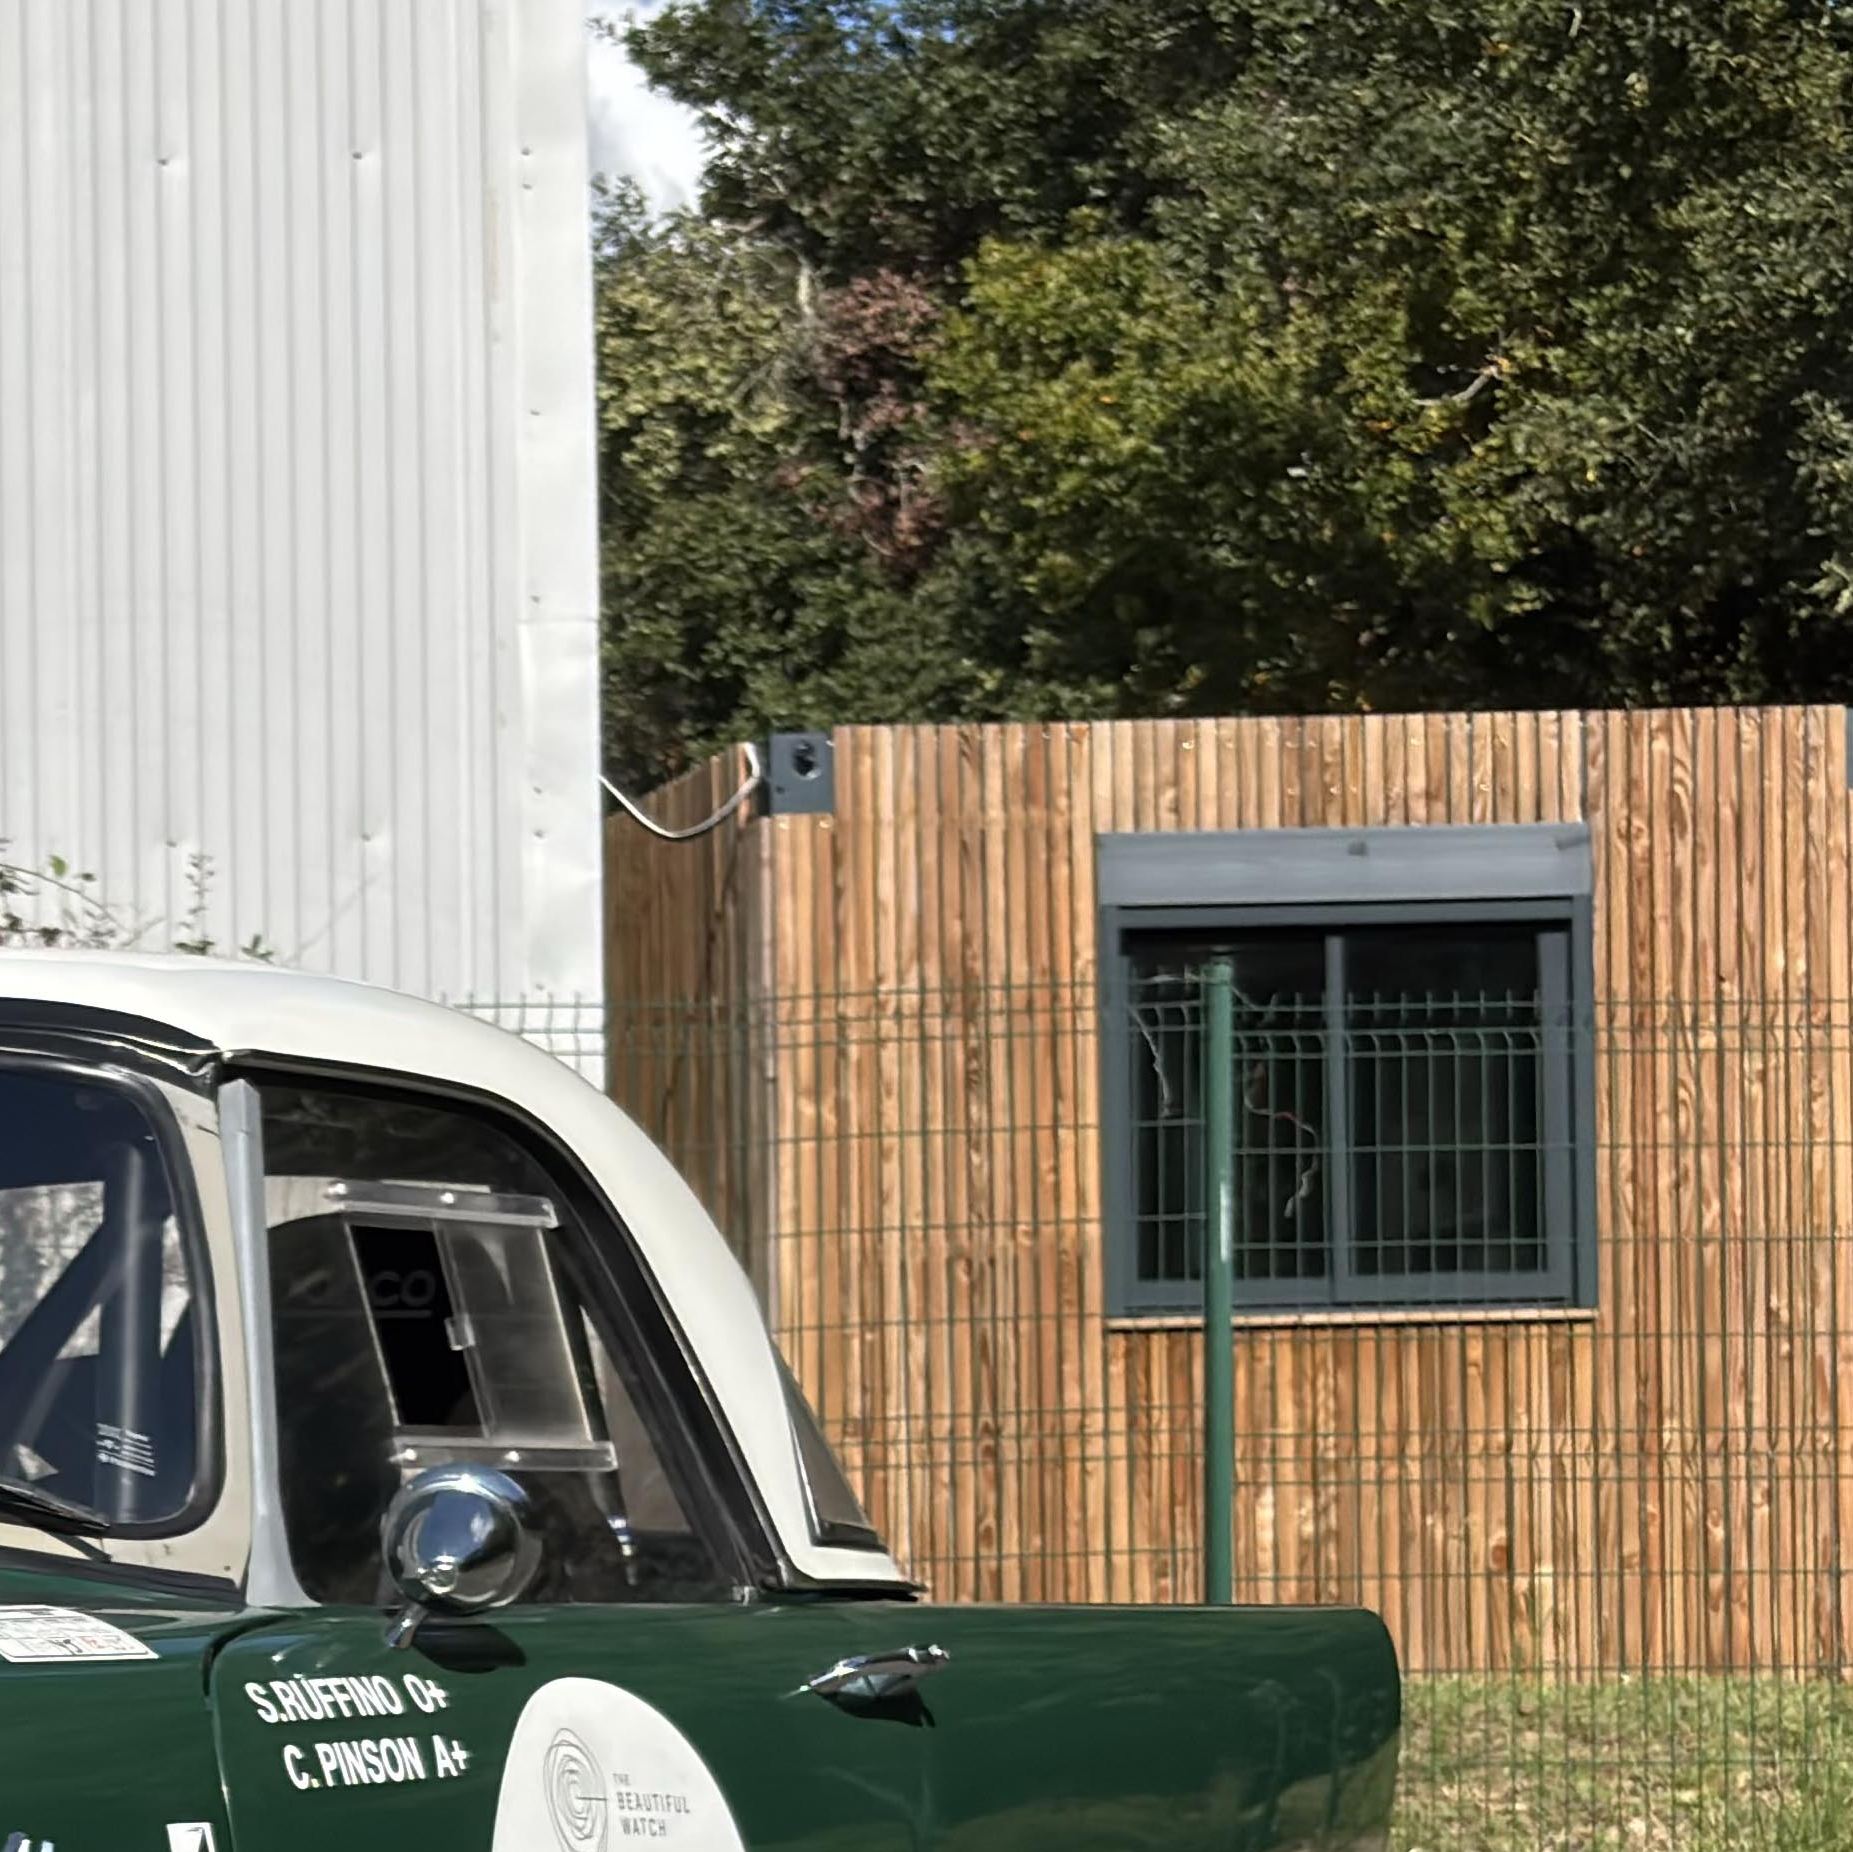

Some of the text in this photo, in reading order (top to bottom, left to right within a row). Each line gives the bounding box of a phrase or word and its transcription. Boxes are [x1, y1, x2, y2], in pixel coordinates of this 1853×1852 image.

[431, 1734, 472, 1778] A+
[616, 1791, 691, 1814] BEAUTIFUL
[620, 1817, 667, 1837] WATCH
